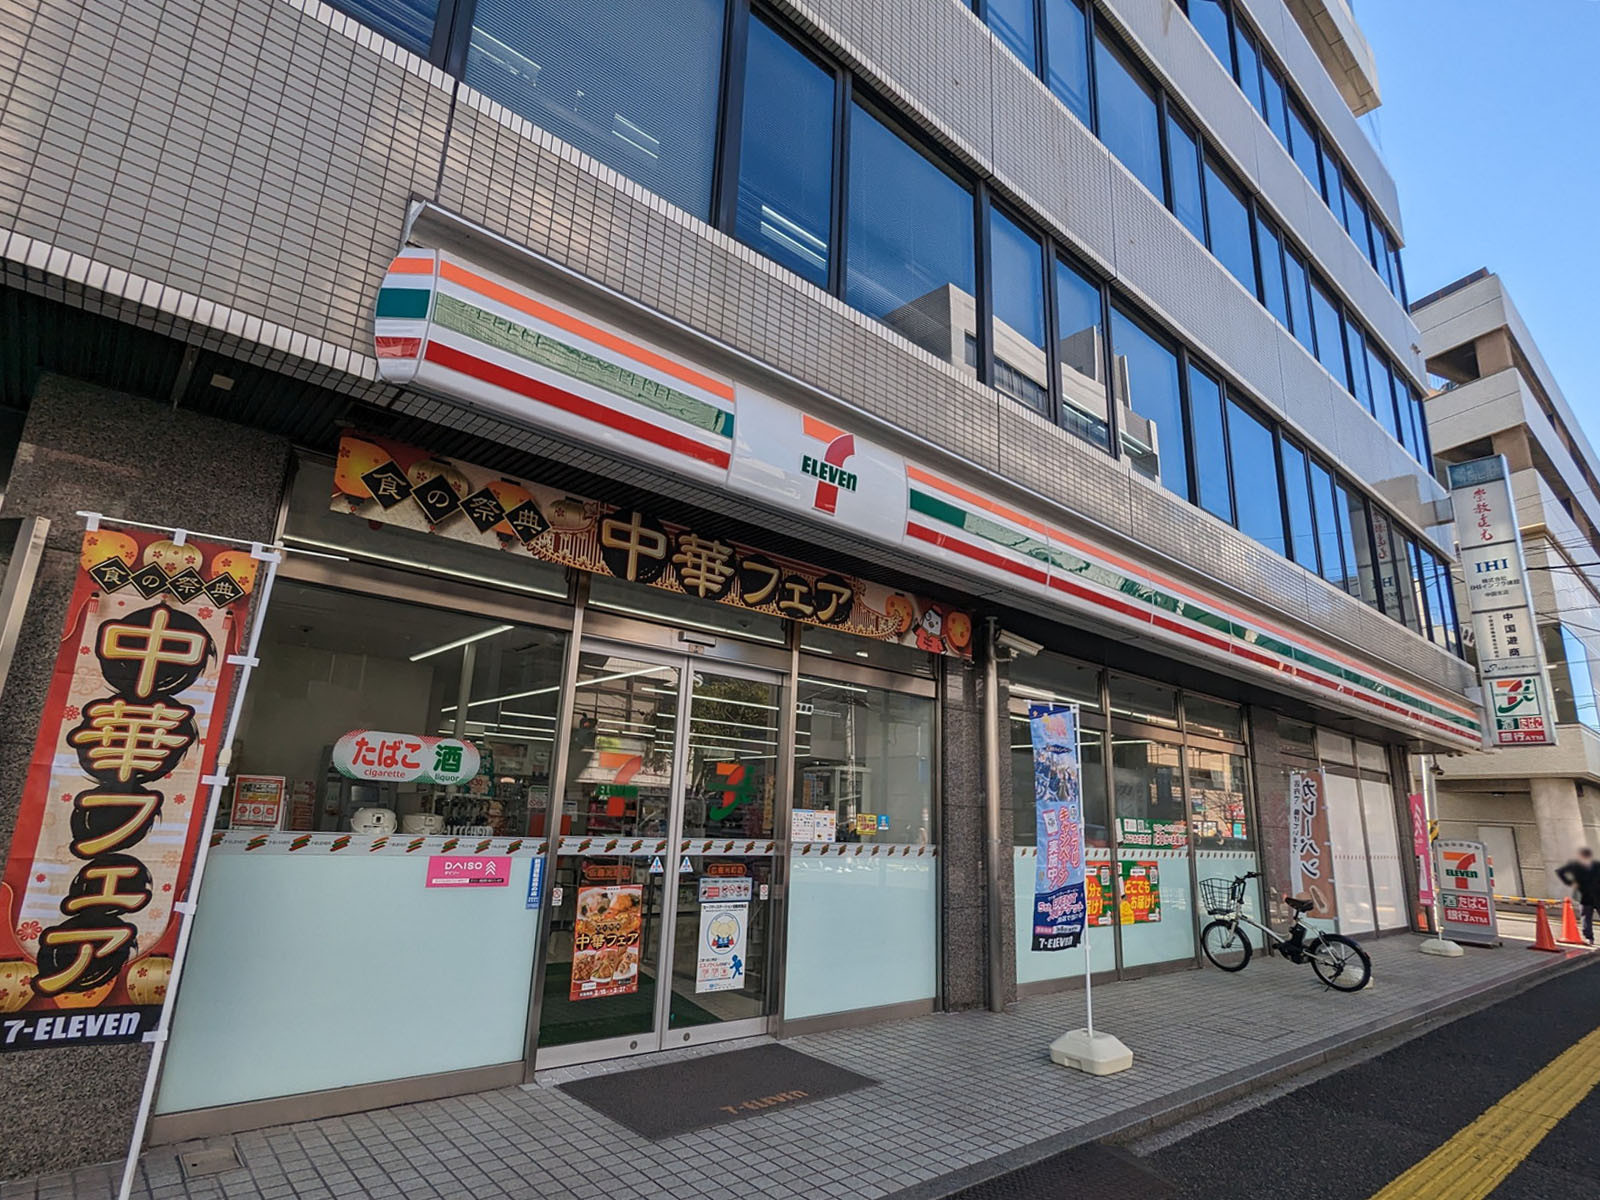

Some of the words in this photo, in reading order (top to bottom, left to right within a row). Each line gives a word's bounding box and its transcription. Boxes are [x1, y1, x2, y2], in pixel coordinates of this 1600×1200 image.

[372, 471, 543, 534] 食の祭典
[601, 510, 852, 621] 中華フェア
[1474, 558, 1509, 574] IHI
[100, 566, 235, 598] 食の祭典
[352, 737, 420, 769] たばこ
[433, 744, 463, 773] 酒
[364, 769, 406, 779] cigarette
[434, 773, 460, 782] liquor
[37, 608, 207, 993] 中華フェア
[1124, 880, 1151, 894] どこでも
[1443, 894, 1457, 907] 酒
[1458, 896, 1488, 910] たばこ
[576, 931, 639, 950] 中華フェア
